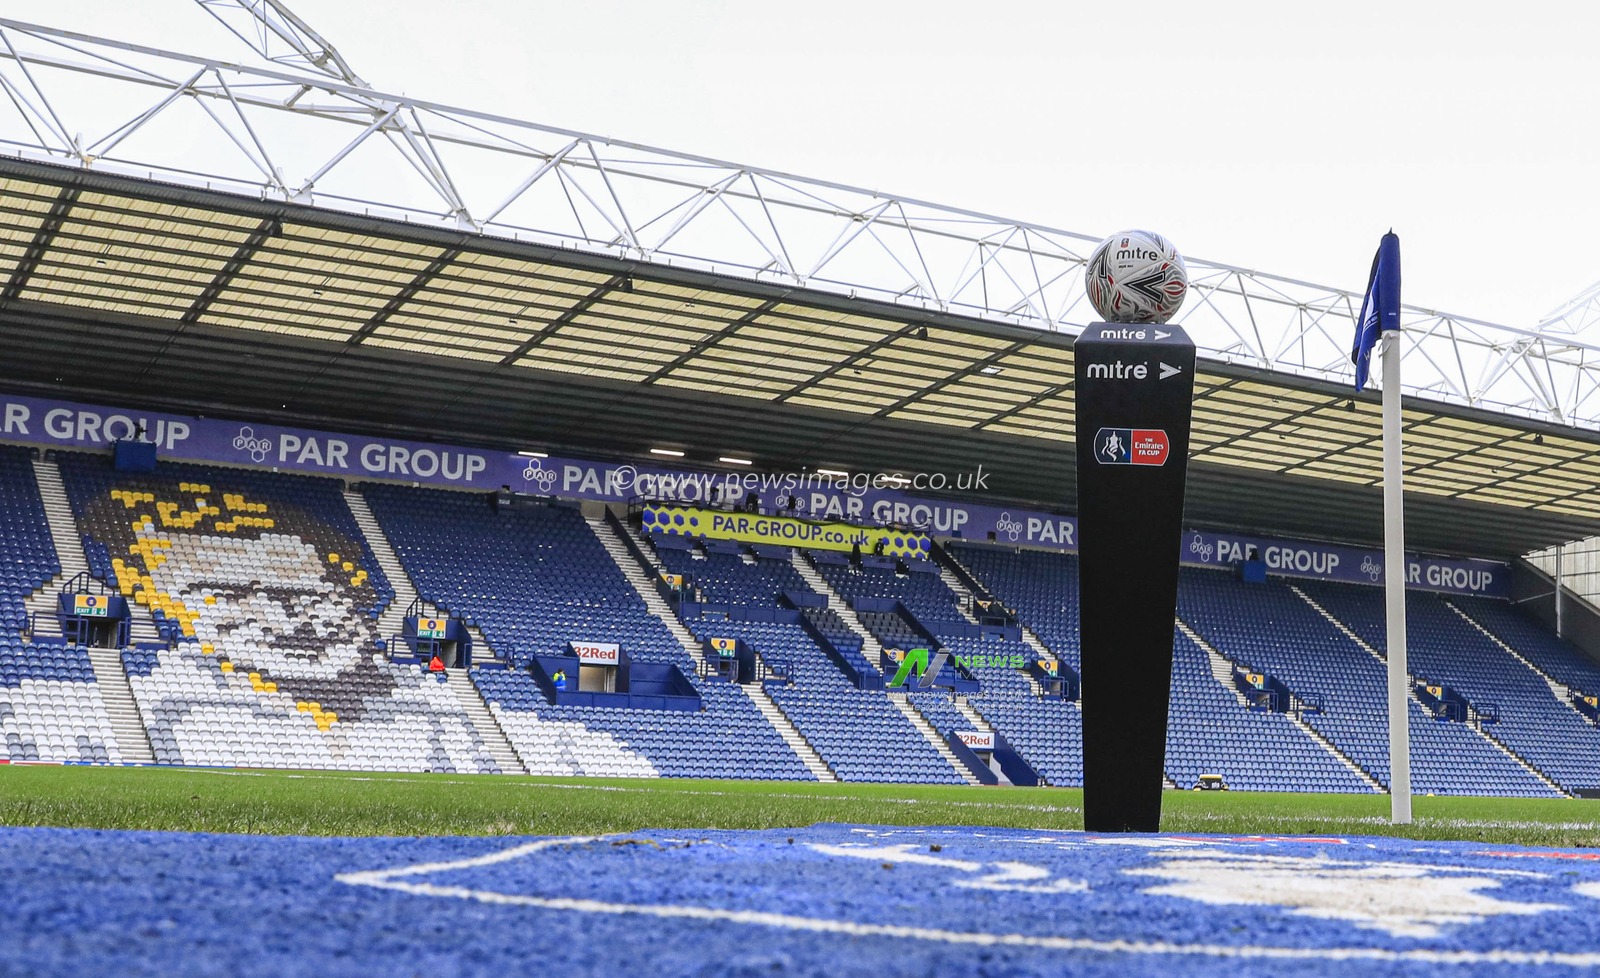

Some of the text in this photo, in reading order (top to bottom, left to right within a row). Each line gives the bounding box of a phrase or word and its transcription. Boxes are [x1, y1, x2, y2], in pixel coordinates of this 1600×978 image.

[1116, 247, 1158, 261] mitre
[1100, 328, 1146, 340] mitre
[1087, 361, 1148, 379] mitre
[0, 402, 190, 450] R GROUP
[279, 434, 486, 481] PAR GROUP
[1134, 441, 1164, 450] Emirates
[563, 465, 623, 497] PAR
[811, 492, 969, 532] PAR GROUP
[713, 515, 869, 546] PAR-GROUP.co.uk
[1027, 517, 1074, 545] PAR
[1265, 546, 1340, 574] GROUP
[1427, 565, 1493, 591] GROUP
